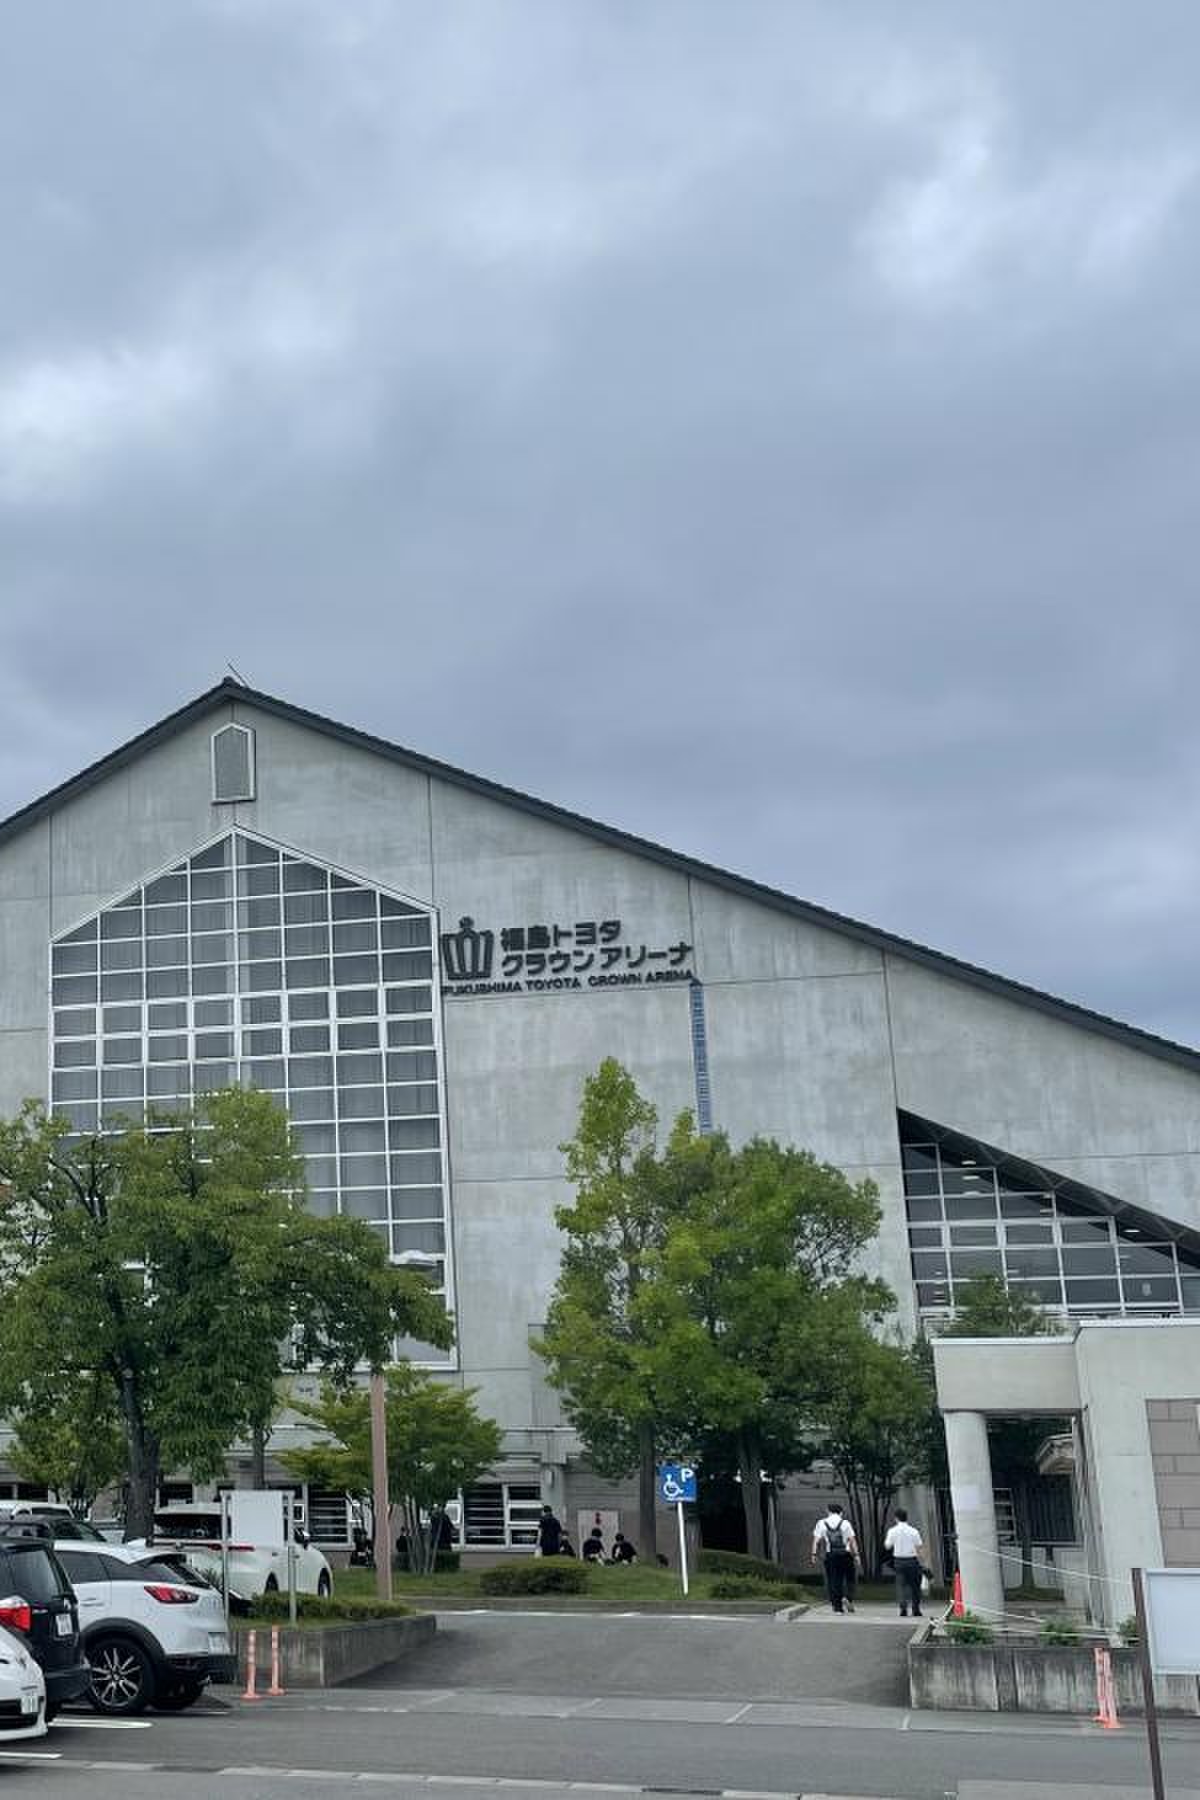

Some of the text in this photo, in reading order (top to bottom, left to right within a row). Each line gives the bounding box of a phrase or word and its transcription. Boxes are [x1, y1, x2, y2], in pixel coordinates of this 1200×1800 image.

[502, 941, 694, 977] クラウンアリーナ
[525, 977, 581, 992] TOYOTA
[588, 972, 641, 987] CROWN
[681, 1468, 695, 1483] P
